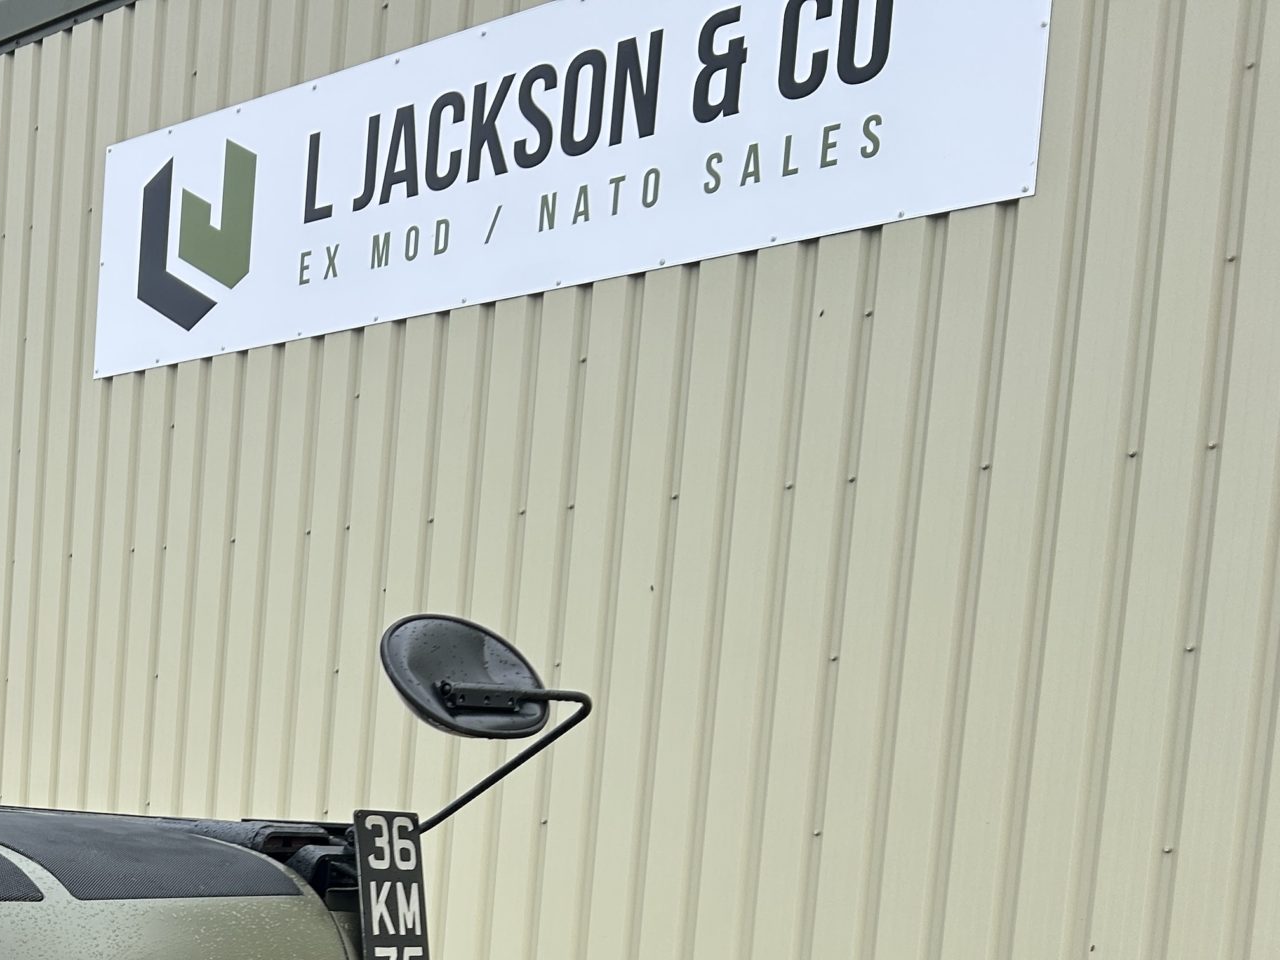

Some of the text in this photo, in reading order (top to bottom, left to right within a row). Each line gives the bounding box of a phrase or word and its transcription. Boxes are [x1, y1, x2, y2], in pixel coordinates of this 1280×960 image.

[304, 0, 894, 224] L JACKSON & CO
[298, 114, 884, 286] EX MOD / NATO SALES
[364, 815, 417, 870] 36
[370, 881, 421, 936] KM
